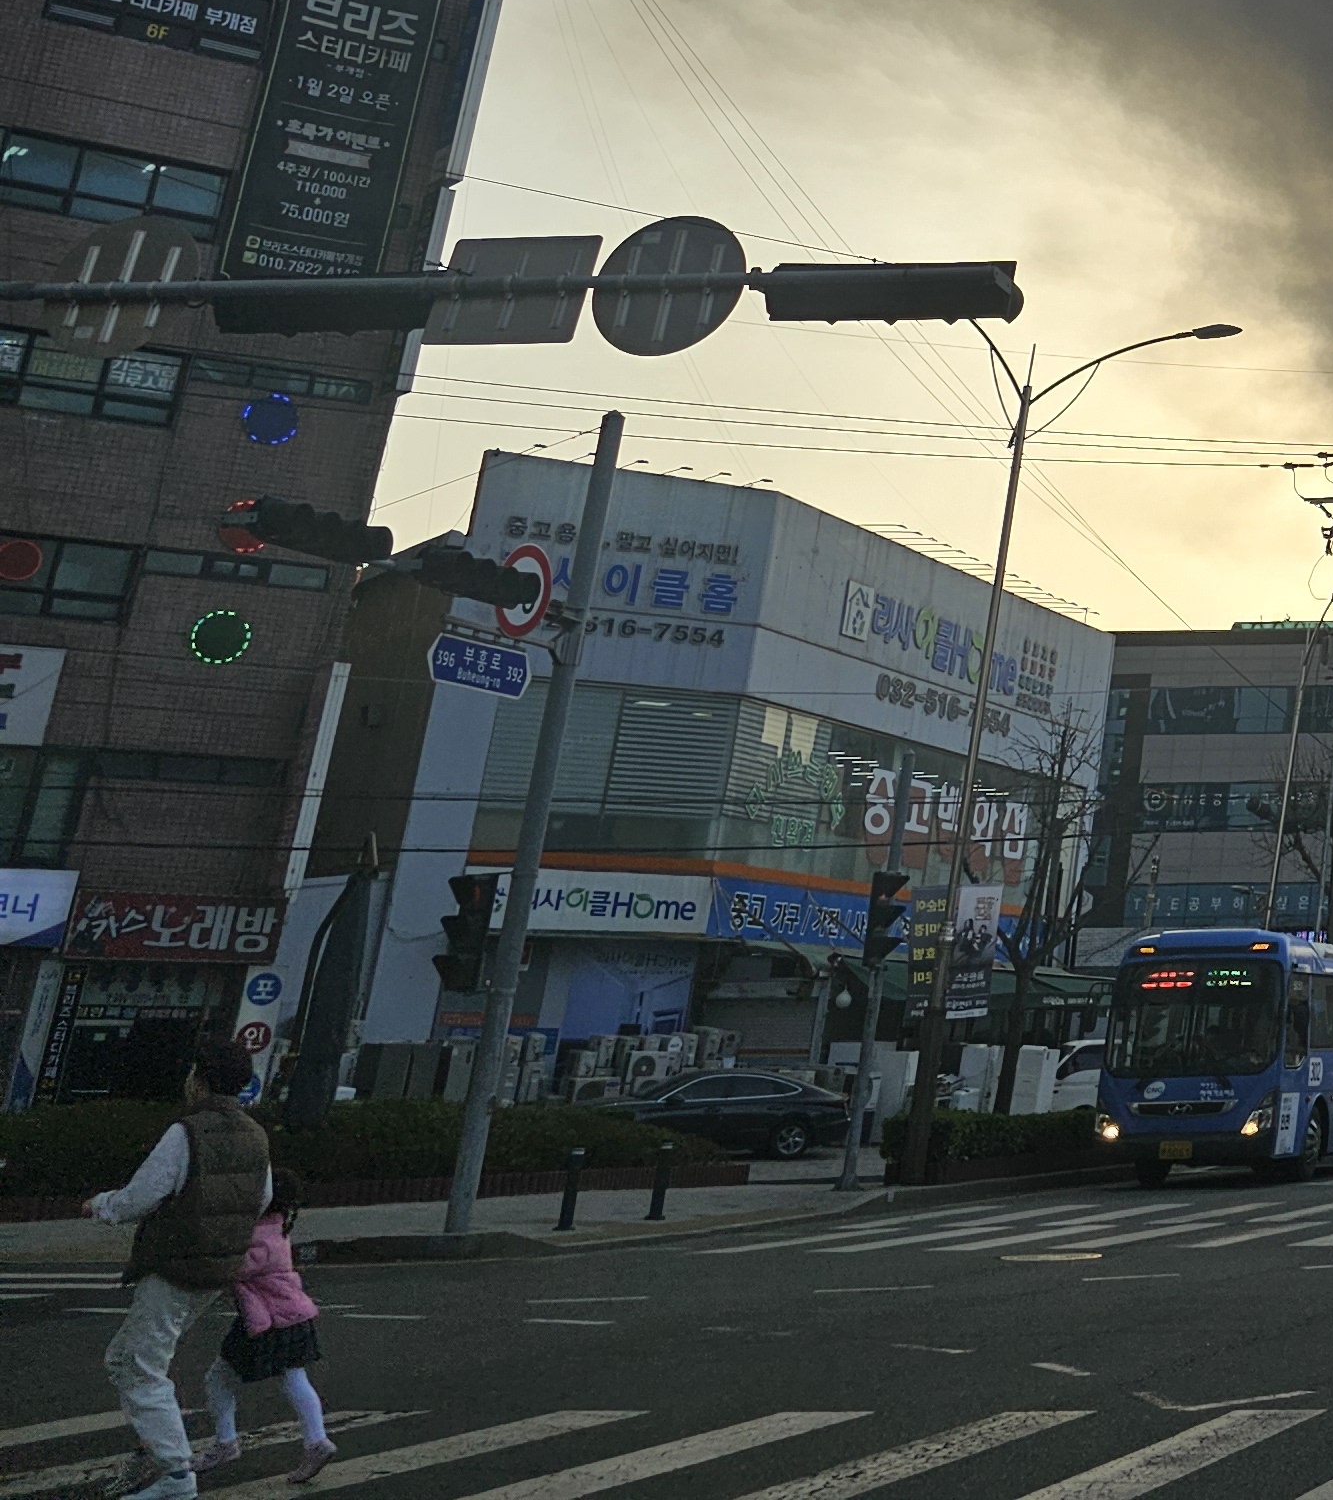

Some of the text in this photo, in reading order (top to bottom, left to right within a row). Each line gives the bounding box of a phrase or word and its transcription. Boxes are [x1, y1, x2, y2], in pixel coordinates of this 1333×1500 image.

[146, 23, 171, 40] 6F
[204, 7, 258, 35] 부개점
[295, 29, 413, 73] 스터디카페
[296, 75, 391, 111] 1월 2일 오픈
[616, 531, 653, 553] 팔고
[658, 536, 740, 566] 싶어지면!
[435, 649, 456, 668] 396
[462, 647, 502, 674] 부흥로
[456, 667, 501, 690] Buheung-ro
[505, 665, 524, 684] 392
[531, 886, 697, 922] 사이클Home
[732, 891, 765, 931] 중고
[770, 898, 801, 935] 가구
[143, 902, 280, 953] 노래방
